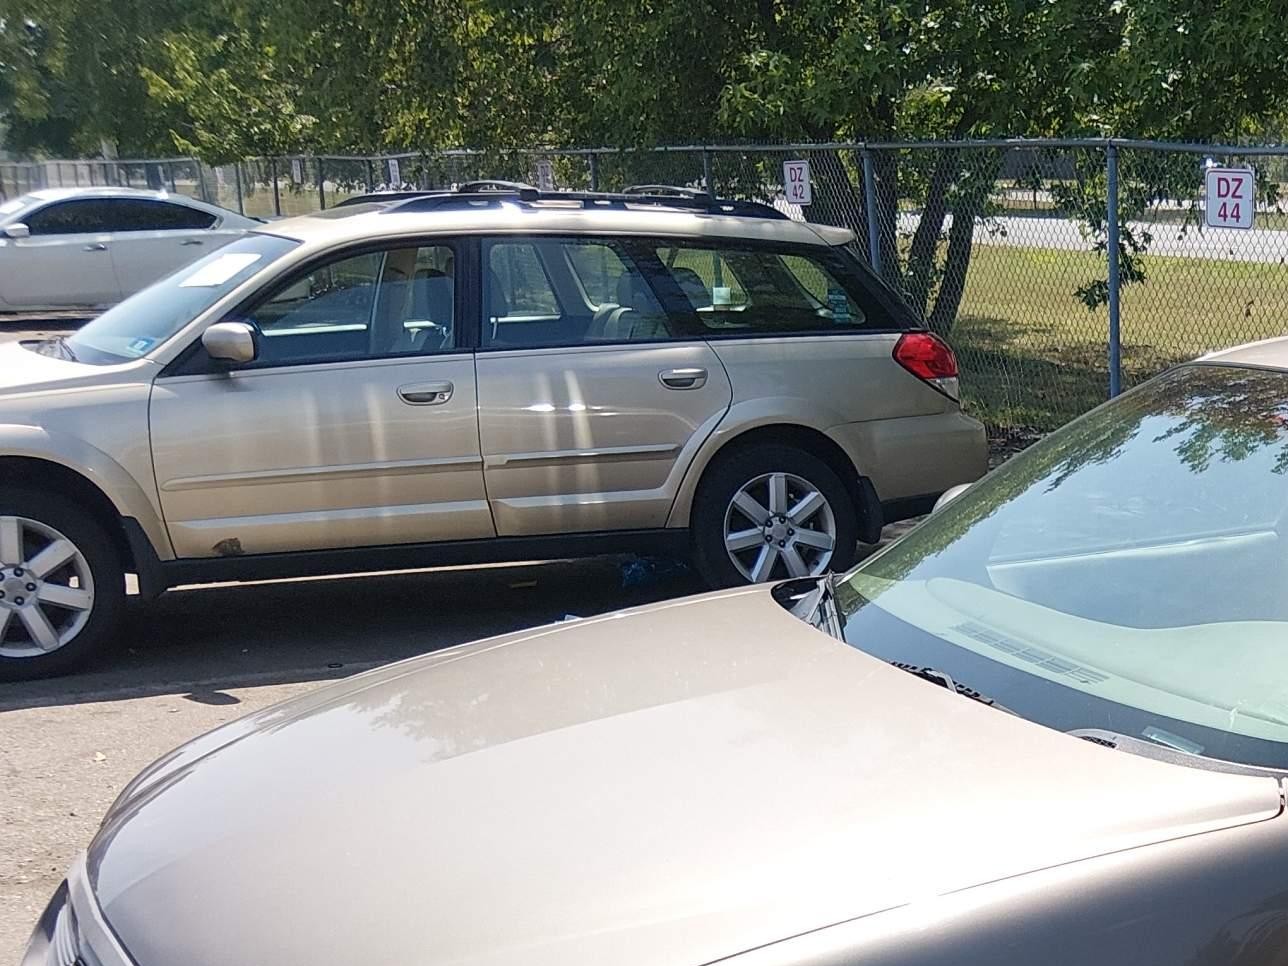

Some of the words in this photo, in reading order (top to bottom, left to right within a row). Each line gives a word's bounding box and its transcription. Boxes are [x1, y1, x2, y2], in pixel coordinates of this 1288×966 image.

[790, 167, 804, 182] DZ
[793, 184, 805, 200] 42
[1217, 177, 1244, 199] DZ
[1217, 202, 1241, 223] 44
